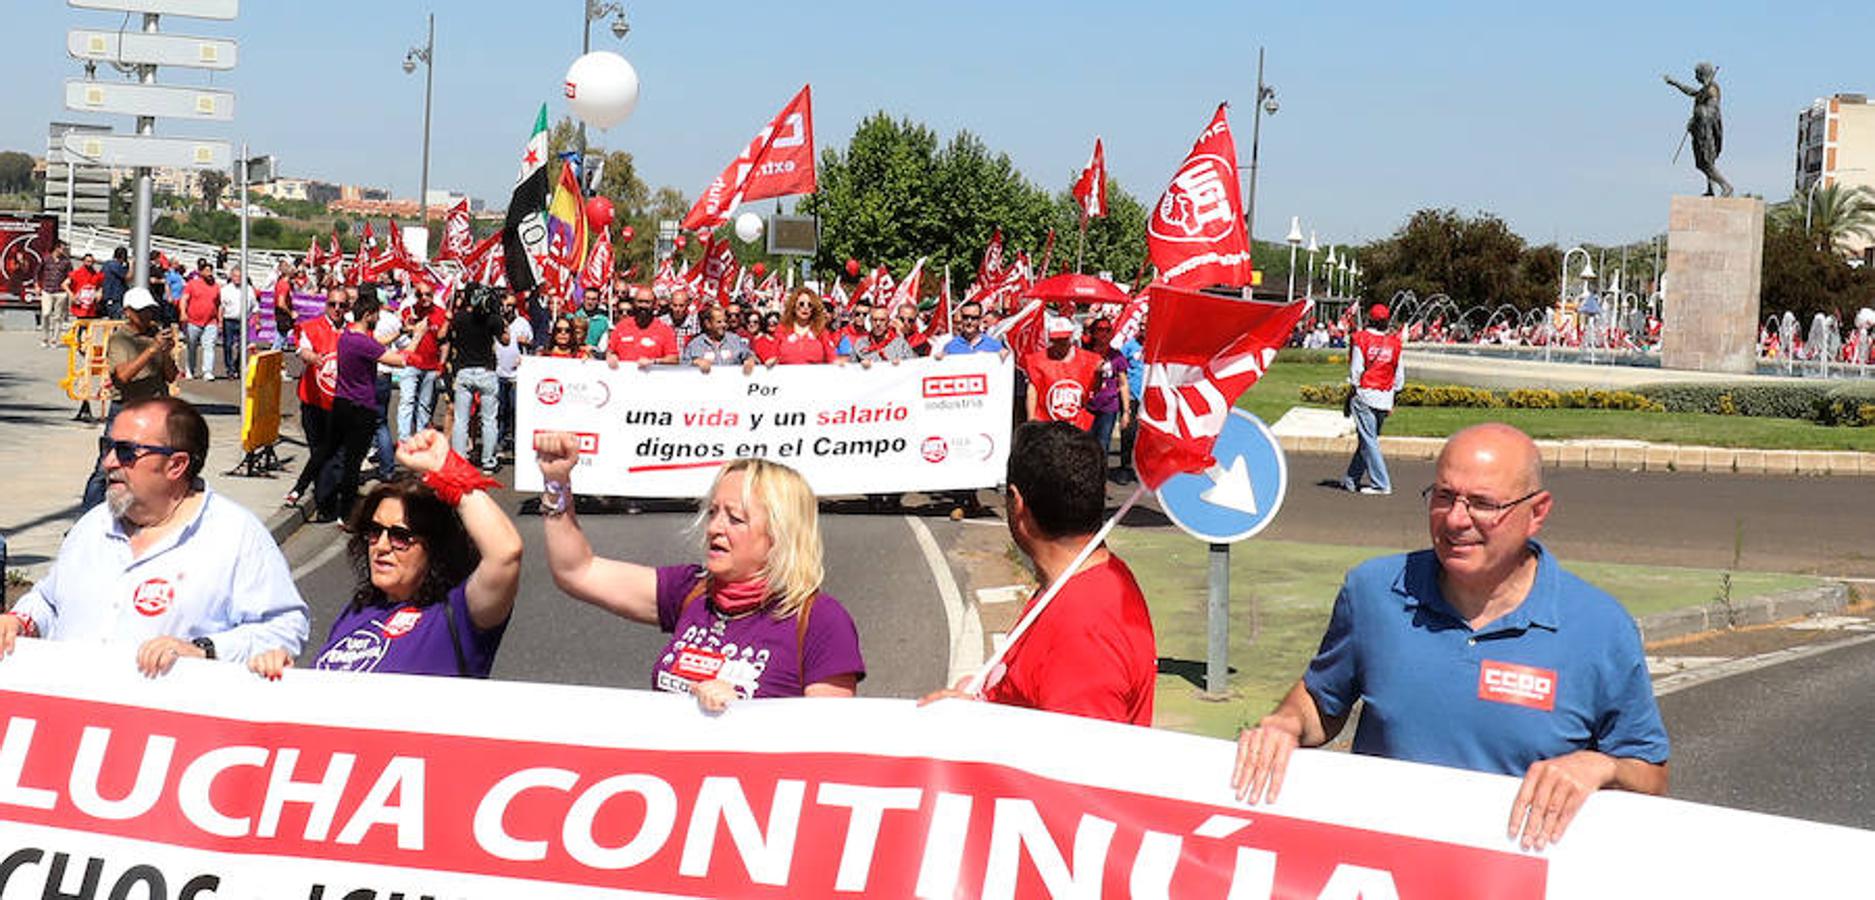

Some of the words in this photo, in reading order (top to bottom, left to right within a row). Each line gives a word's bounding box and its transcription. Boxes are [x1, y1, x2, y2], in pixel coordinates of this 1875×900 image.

[747, 383, 779, 396] Por
[925, 376, 984, 395] CCOO
[626, 410, 672, 426] una
[684, 408, 739, 427] vida
[750, 413, 763, 431] y
[774, 411, 806, 426] un
[816, 402, 908, 425] salario
[636, 437, 724, 461] dignos
[736, 443, 768, 457] en
[779, 438, 803, 457] el
[813, 437, 907, 458] Campo
[658, 674, 692, 693] CCO
[1485, 668, 1551, 694] CCOO
[0, 716, 426, 851] LUCHA
